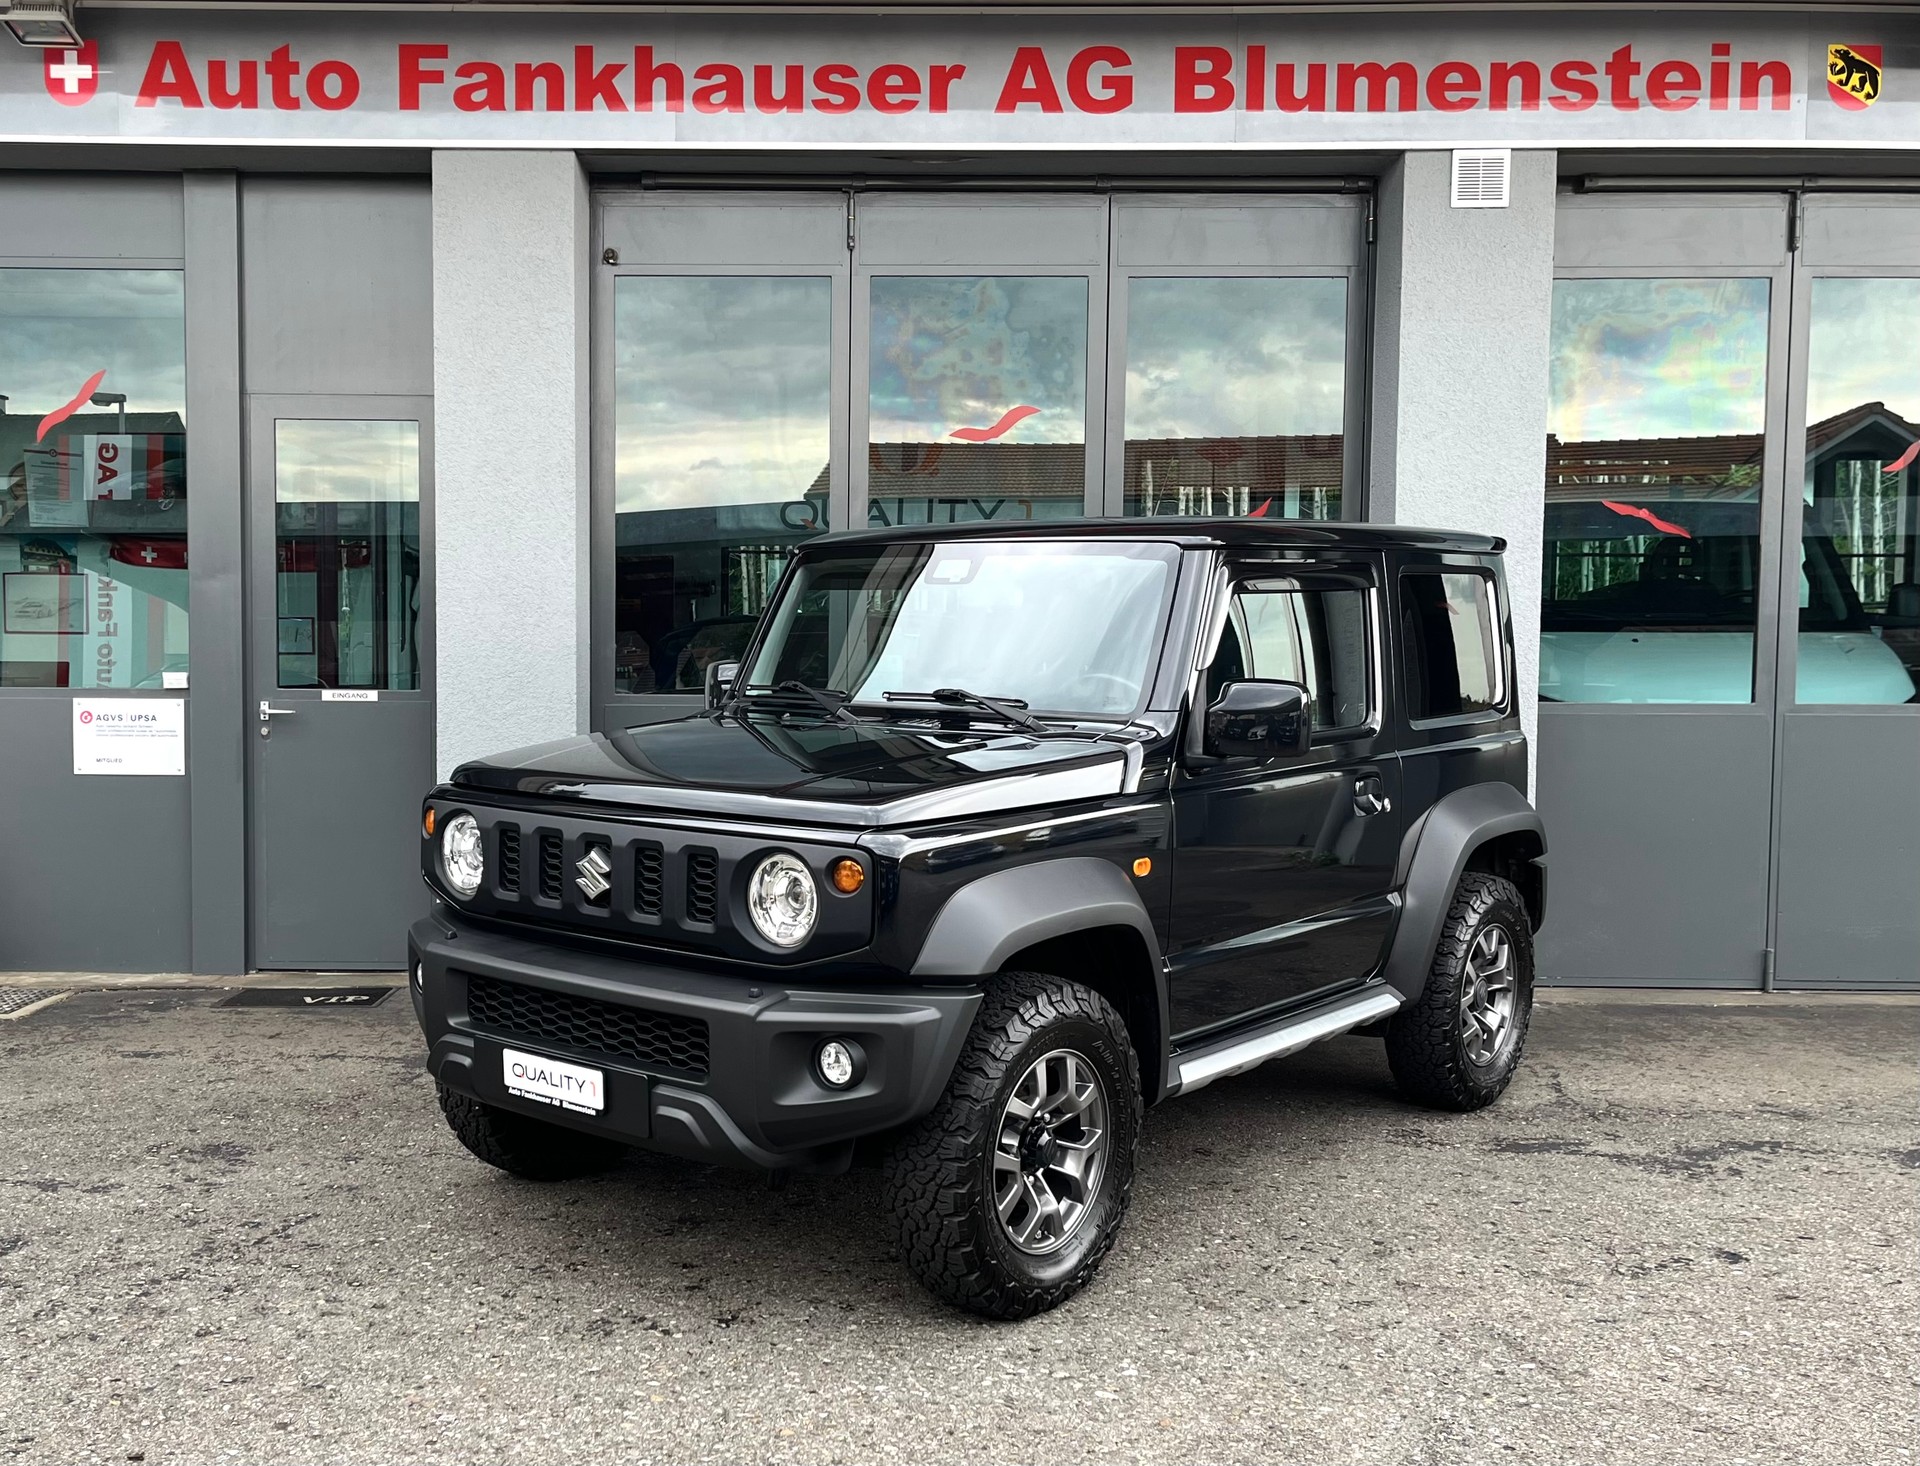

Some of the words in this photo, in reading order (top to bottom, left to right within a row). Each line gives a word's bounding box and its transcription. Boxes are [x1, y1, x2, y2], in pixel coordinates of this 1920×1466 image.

[136, 41, 360, 111] Auto
[399, 44, 966, 114] Fankhauser
[996, 45, 1134, 114] AG
[1174, 43, 1792, 113] Blumenstein
[95, 714, 123, 722] AGVS
[130, 714, 157, 722] UPSA
[303, 995, 370, 1004] VIP
[511, 1063, 586, 1094] QUALITY
[589, 1081, 597, 1097] 1
